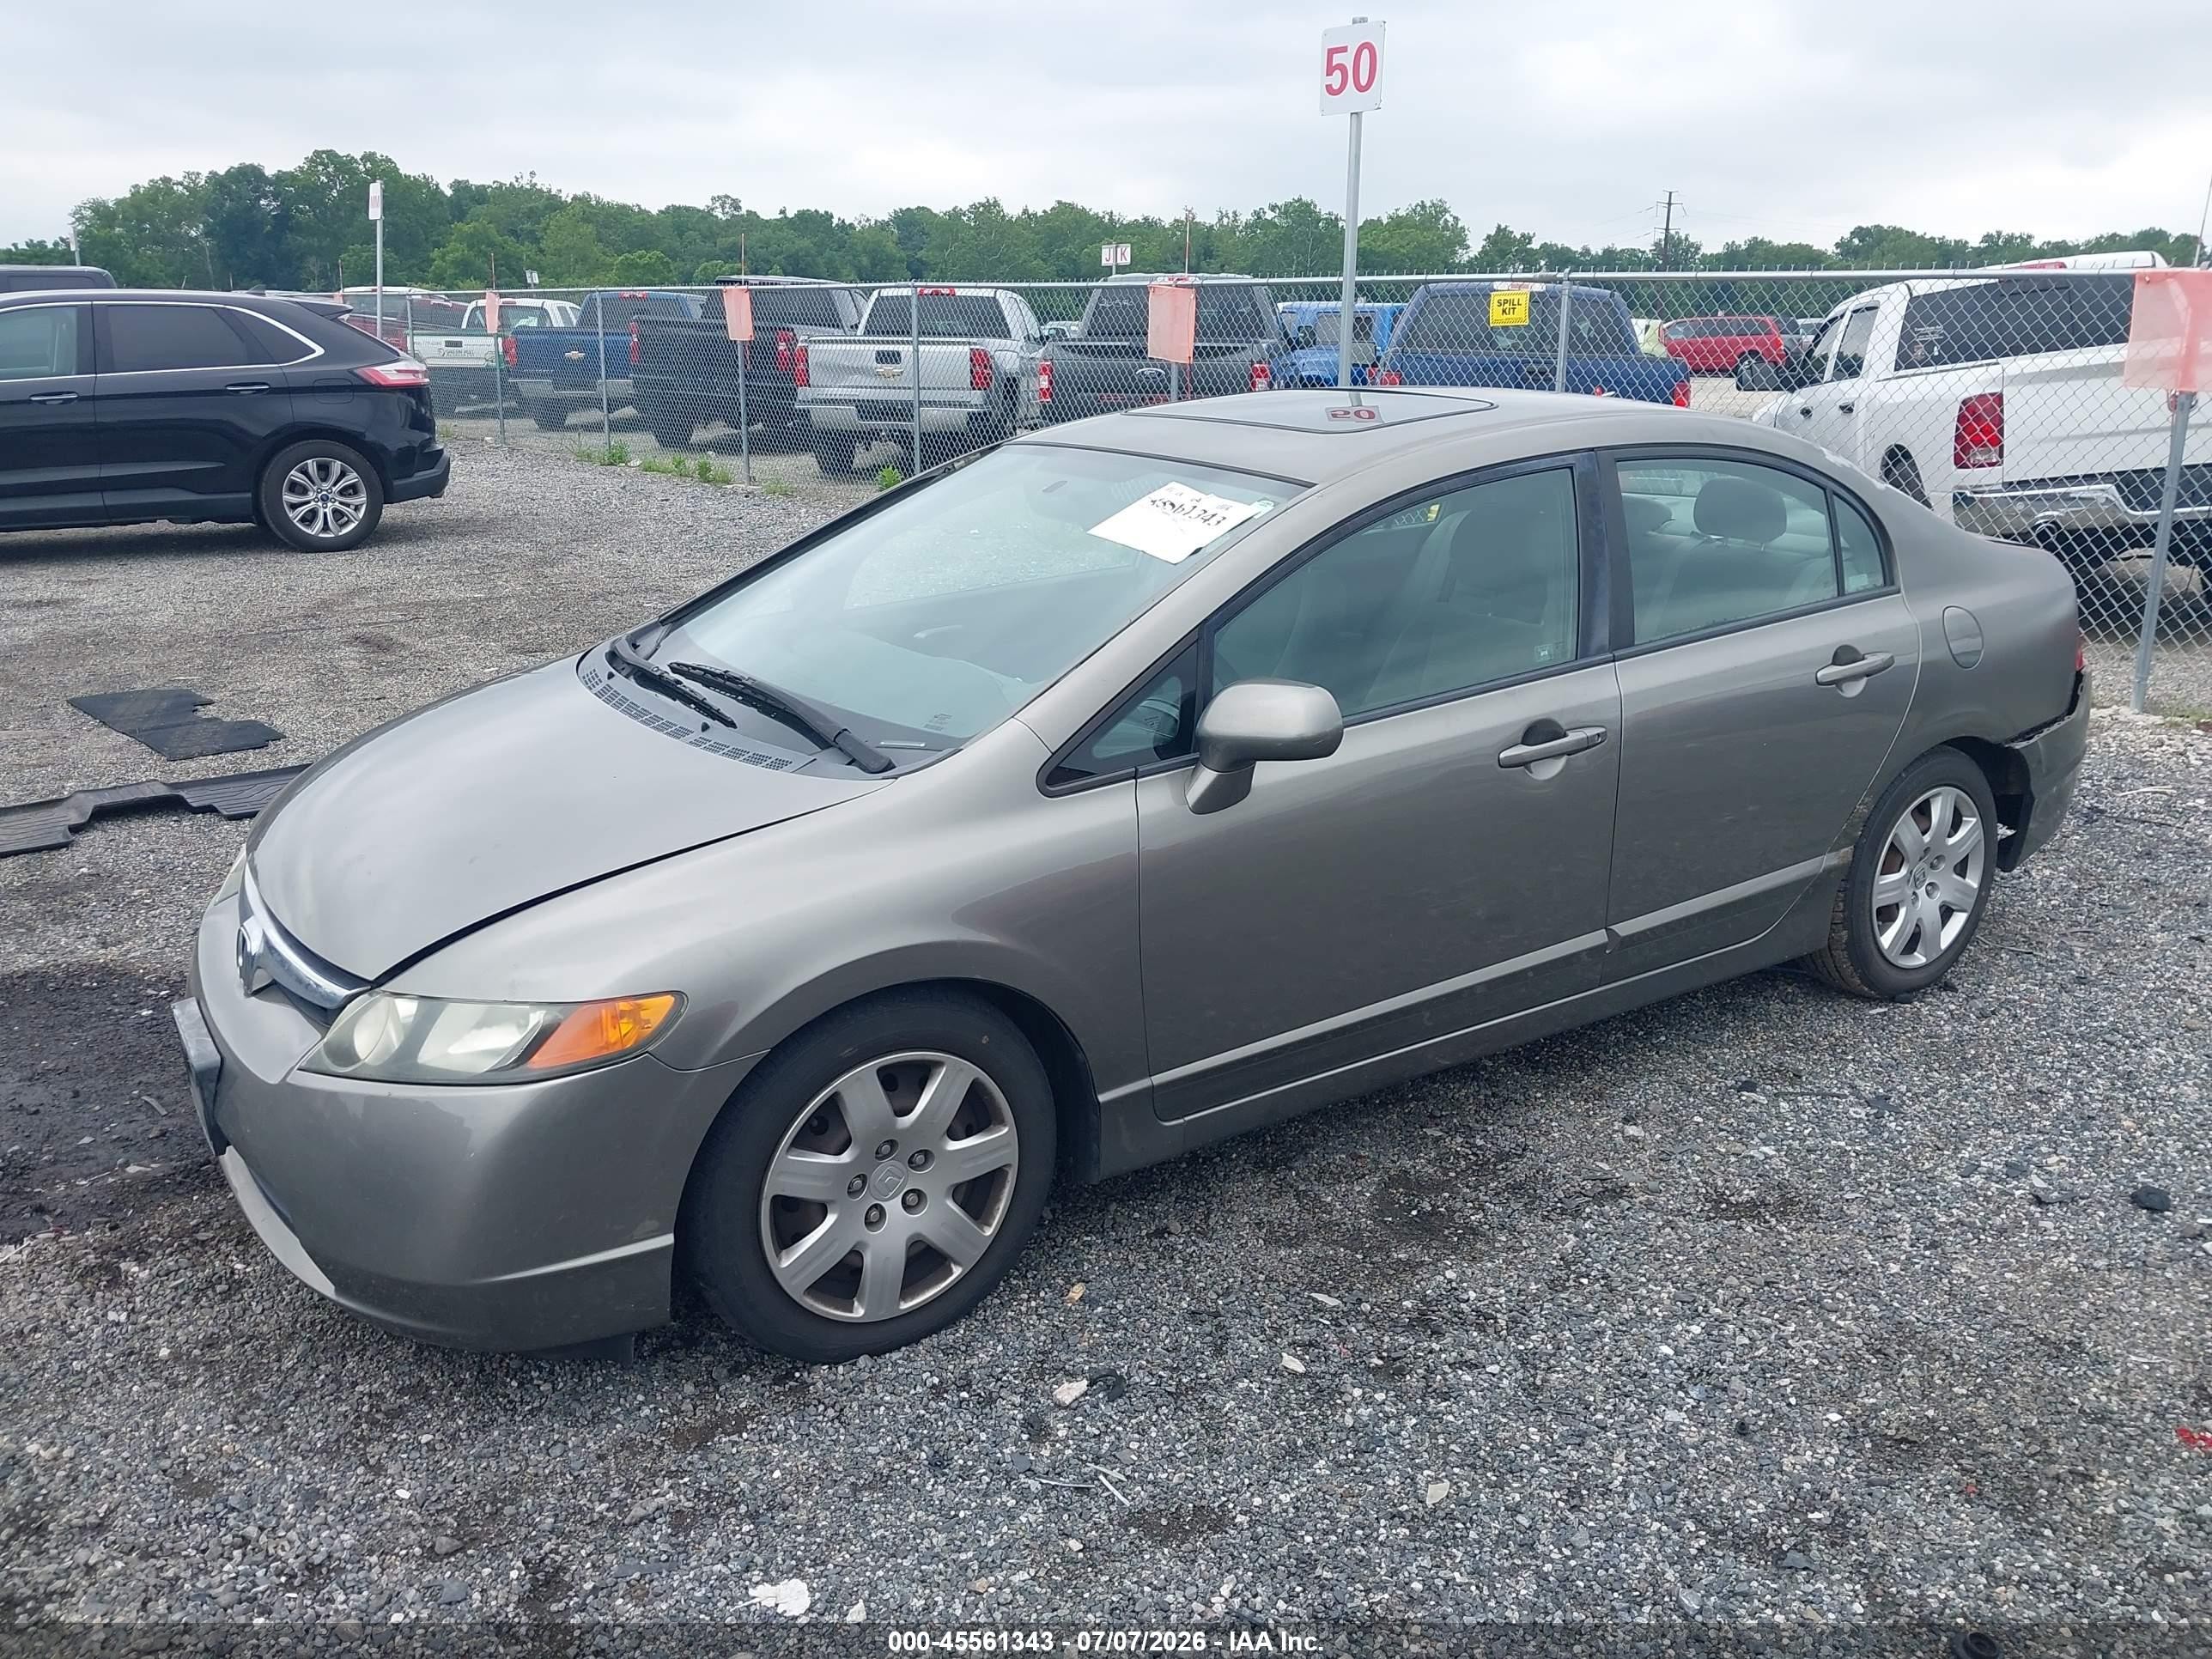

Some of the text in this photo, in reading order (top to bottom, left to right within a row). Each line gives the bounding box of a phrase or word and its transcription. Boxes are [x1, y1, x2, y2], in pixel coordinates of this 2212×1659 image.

[1325, 40, 1377, 97] 50
[1105, 247, 1111, 263] J
[1120, 247, 1127, 262] K
[1497, 298, 1522, 307] SPILL
[1502, 307, 1517, 316] KIT
